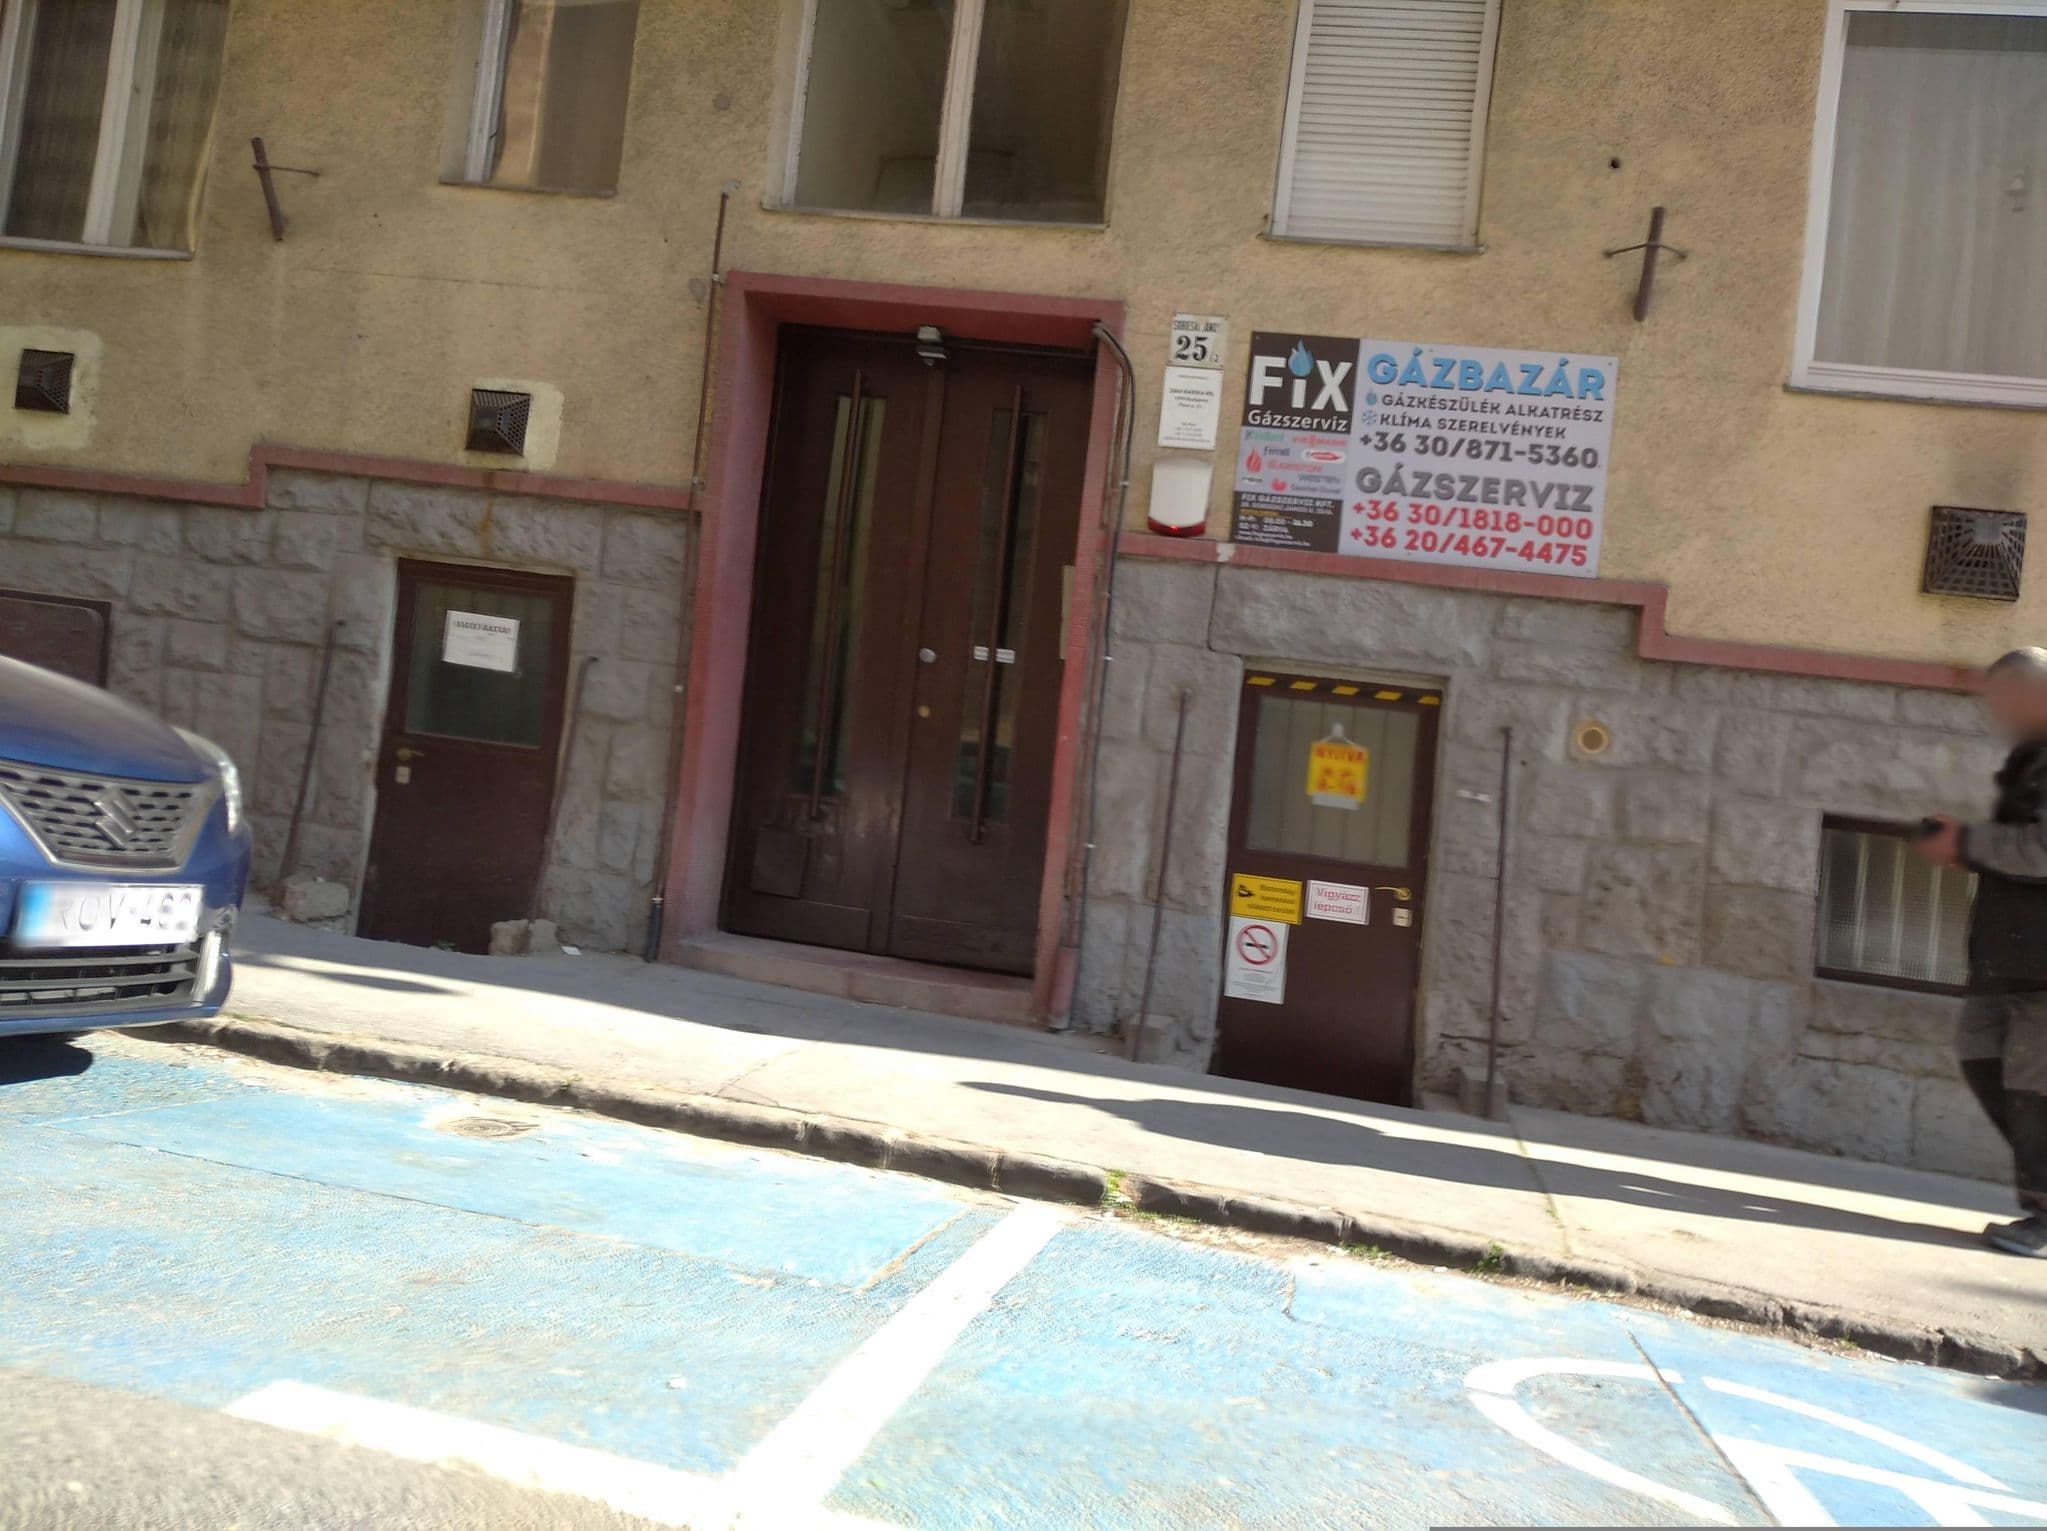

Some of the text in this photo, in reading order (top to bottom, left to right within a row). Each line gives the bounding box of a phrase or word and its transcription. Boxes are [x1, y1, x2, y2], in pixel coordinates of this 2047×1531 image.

[1175, 335, 1208, 361] 25
[1367, 346, 1606, 401] GÁZBAZÁR
[1380, 411, 1567, 439] KLÍMA SZERELVÉNYEK
[1381, 393, 1604, 423] GÁZKÉSZÜLÉK ALKATRÉSZ
[1360, 430, 1598, 469] +36 30/871-5360
[1355, 462, 1594, 513] GÁZSZERVIZ
[1353, 500, 1399, 522] +36
[1407, 503, 1594, 540] 30/1818-000
[1351, 525, 1588, 566] +36 20/467-4475
